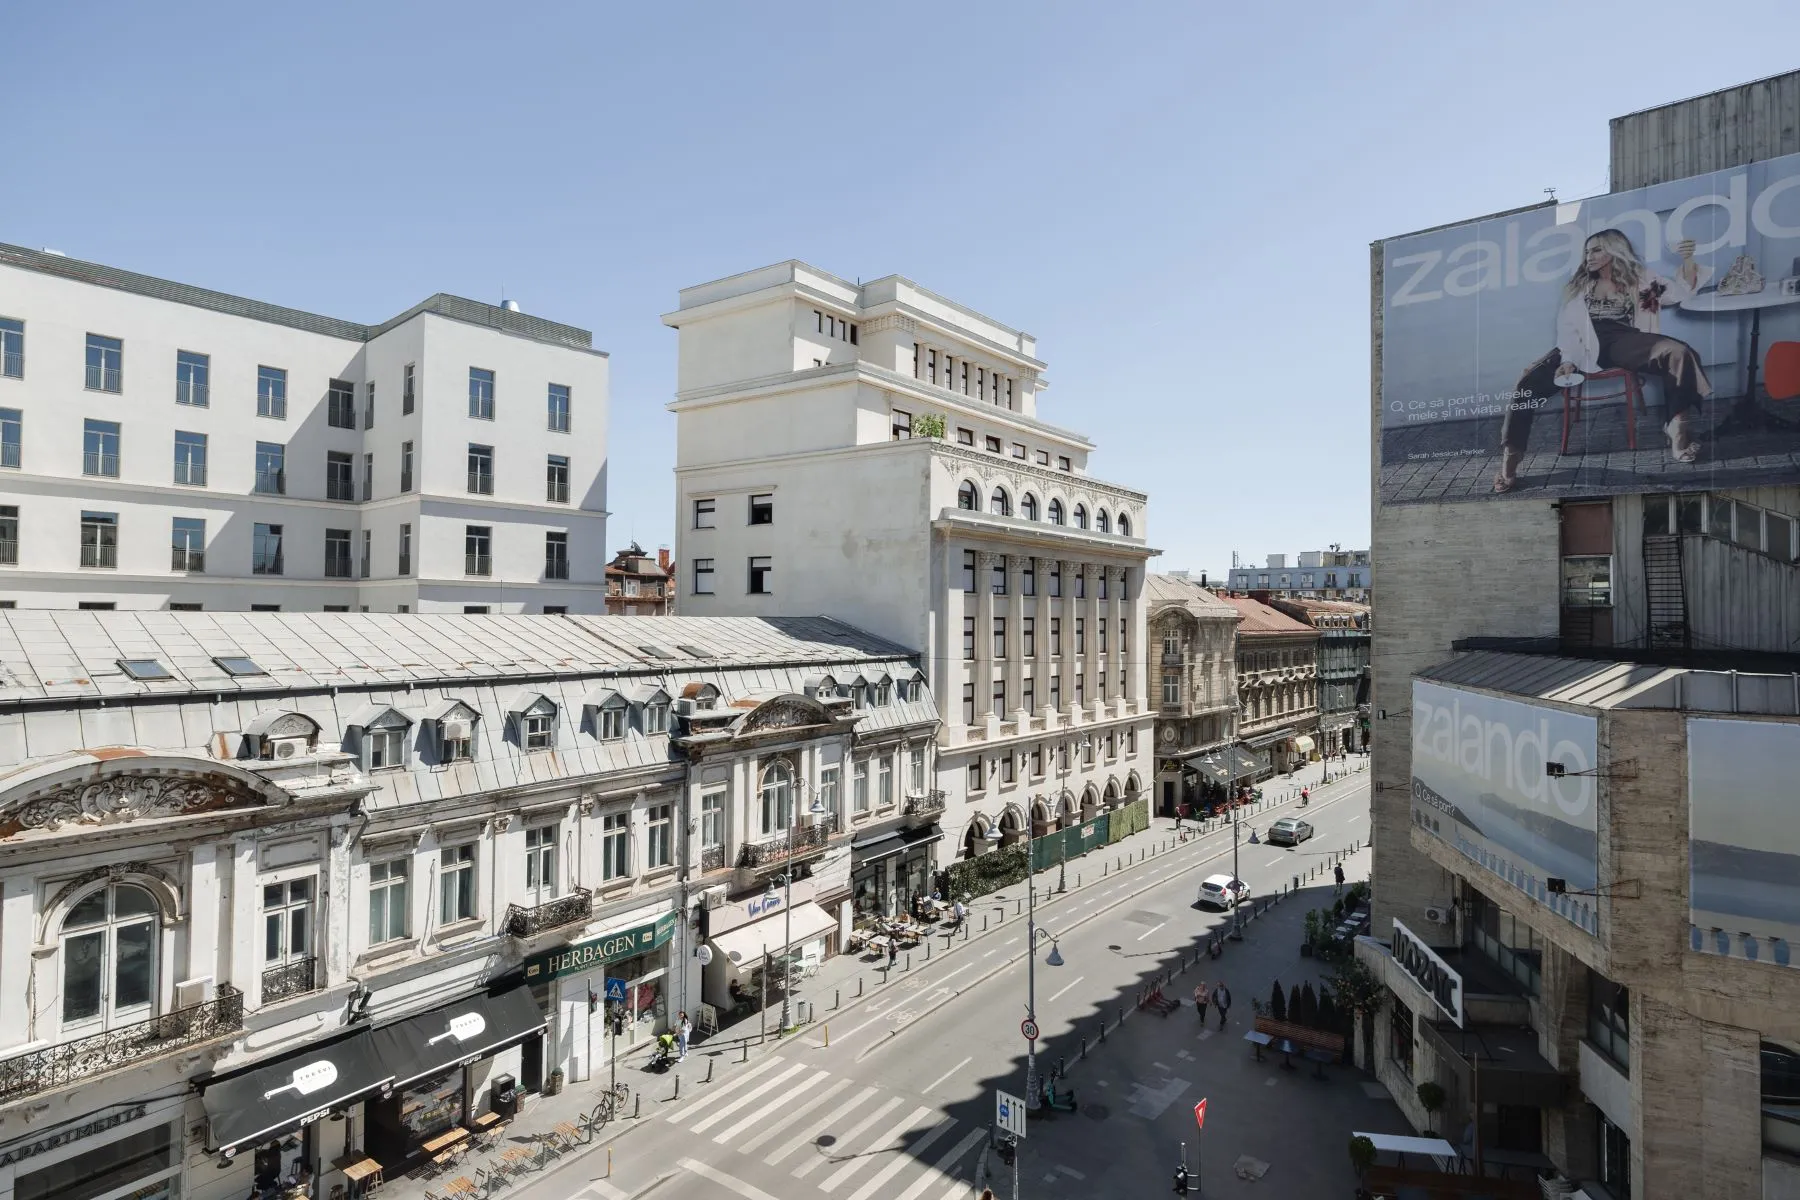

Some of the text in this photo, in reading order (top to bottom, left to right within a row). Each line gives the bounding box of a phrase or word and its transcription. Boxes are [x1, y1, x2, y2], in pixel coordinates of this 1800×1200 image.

[1408, 388, 1533, 410] Ce să port în visele
[1408, 408, 1438, 421] mele
[1455, 406, 1467, 417] în
[1505, 397, 1547, 411] reală?
[1408, 452, 1430, 460] Sarah
[1413, 698, 1591, 816] zalando
[548, 934, 636, 974] HERBAGEN
[1025, 1024, 1035, 1036] 30
[300, 1107, 330, 1126] PEPSI
